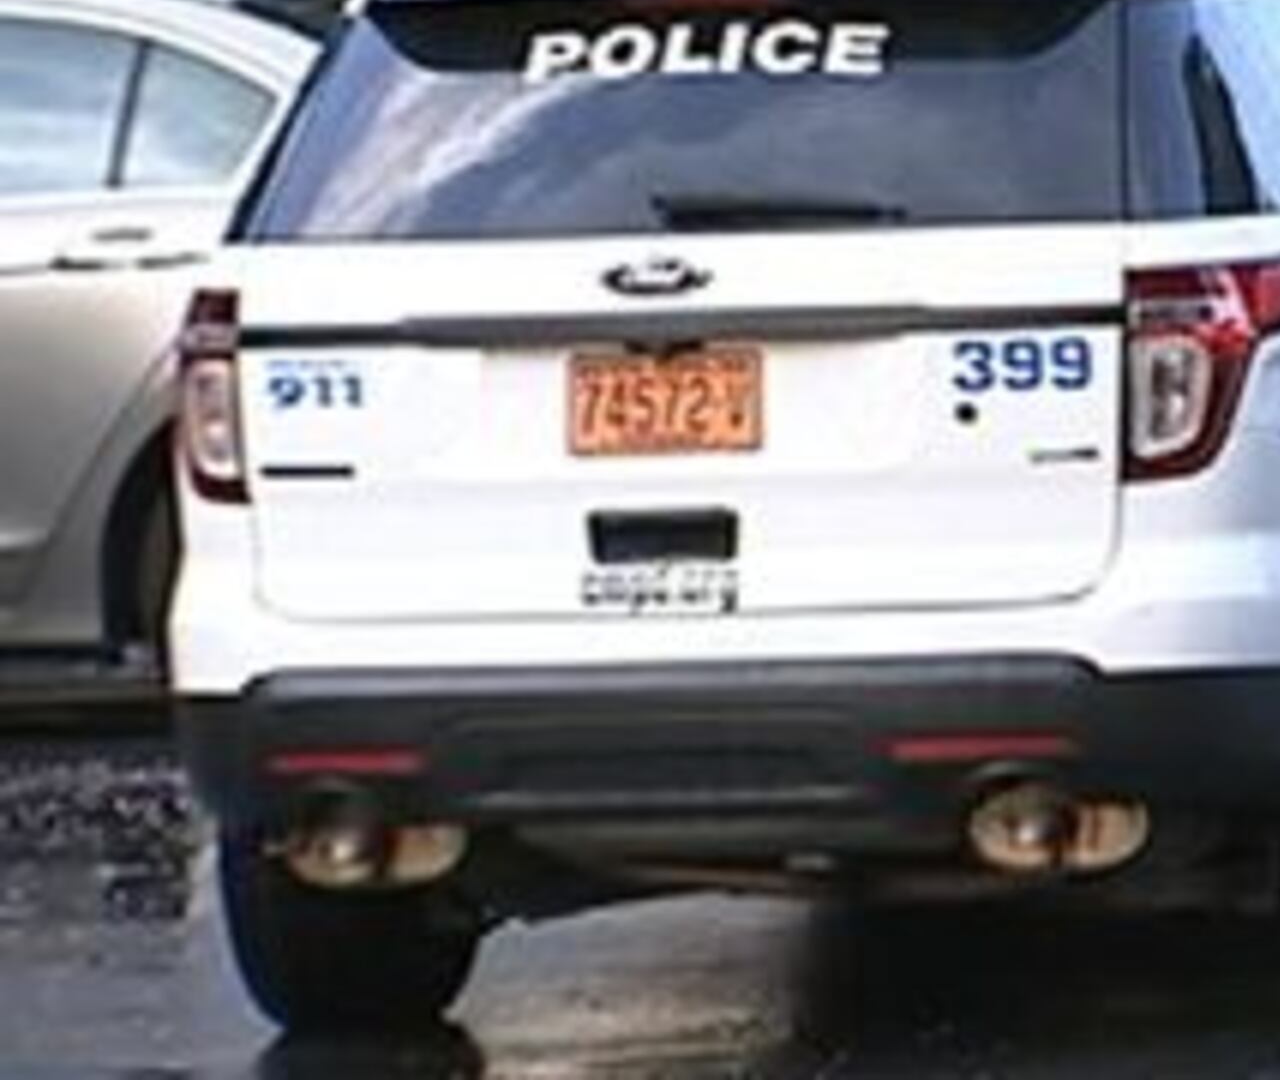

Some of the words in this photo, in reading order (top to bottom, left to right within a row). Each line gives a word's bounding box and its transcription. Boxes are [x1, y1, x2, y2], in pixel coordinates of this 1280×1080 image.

[522, 19, 890, 84] POLICE
[953, 337, 1092, 391] 399
[268, 375, 362, 409] 911
